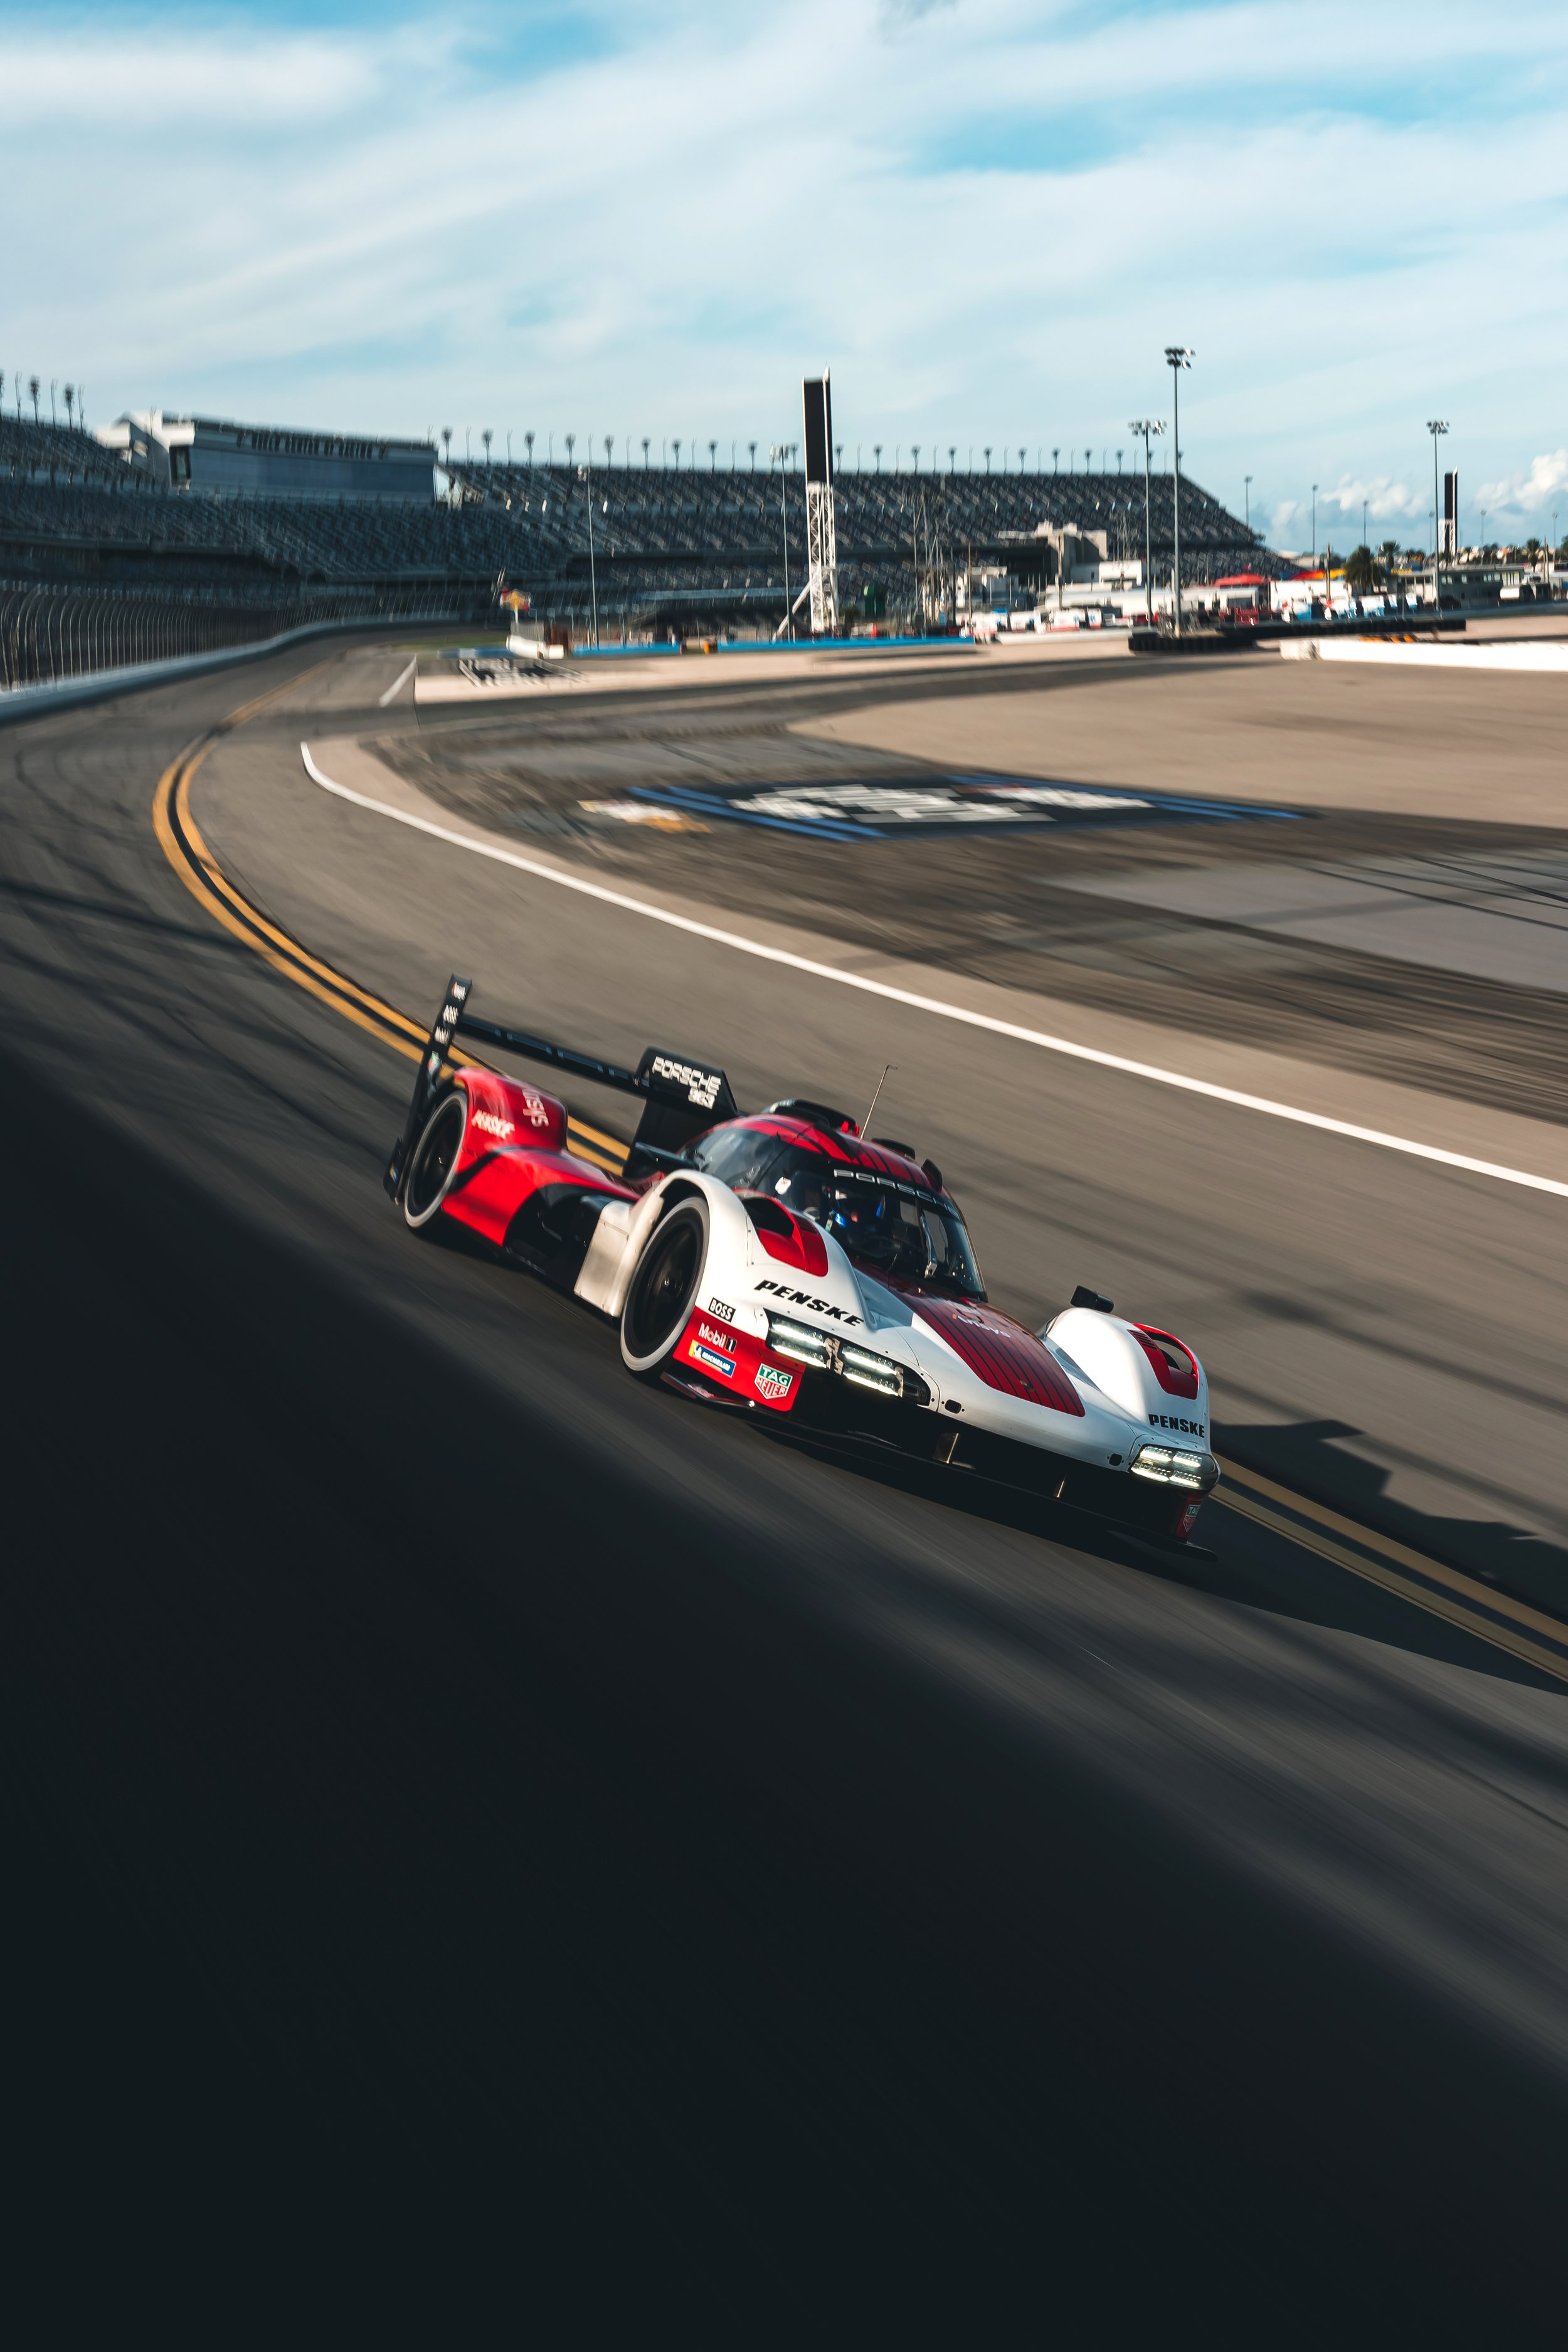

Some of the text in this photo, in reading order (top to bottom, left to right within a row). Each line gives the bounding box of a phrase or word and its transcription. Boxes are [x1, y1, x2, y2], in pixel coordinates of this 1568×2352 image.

[652, 1056, 721, 1096] PORSCHE
[834, 1169, 961, 1221] PORSCHE
[710, 1299, 733, 1320] BOSS
[754, 1279, 864, 1327] PENSKE
[698, 1322, 726, 1348] Mobil
[702, 1351, 731, 1372] MICHELIN
[756, 1376, 786, 1396] HEUER
[762, 1366, 789, 1385] TAG
[1148, 1414, 1205, 1438] PENSKE
